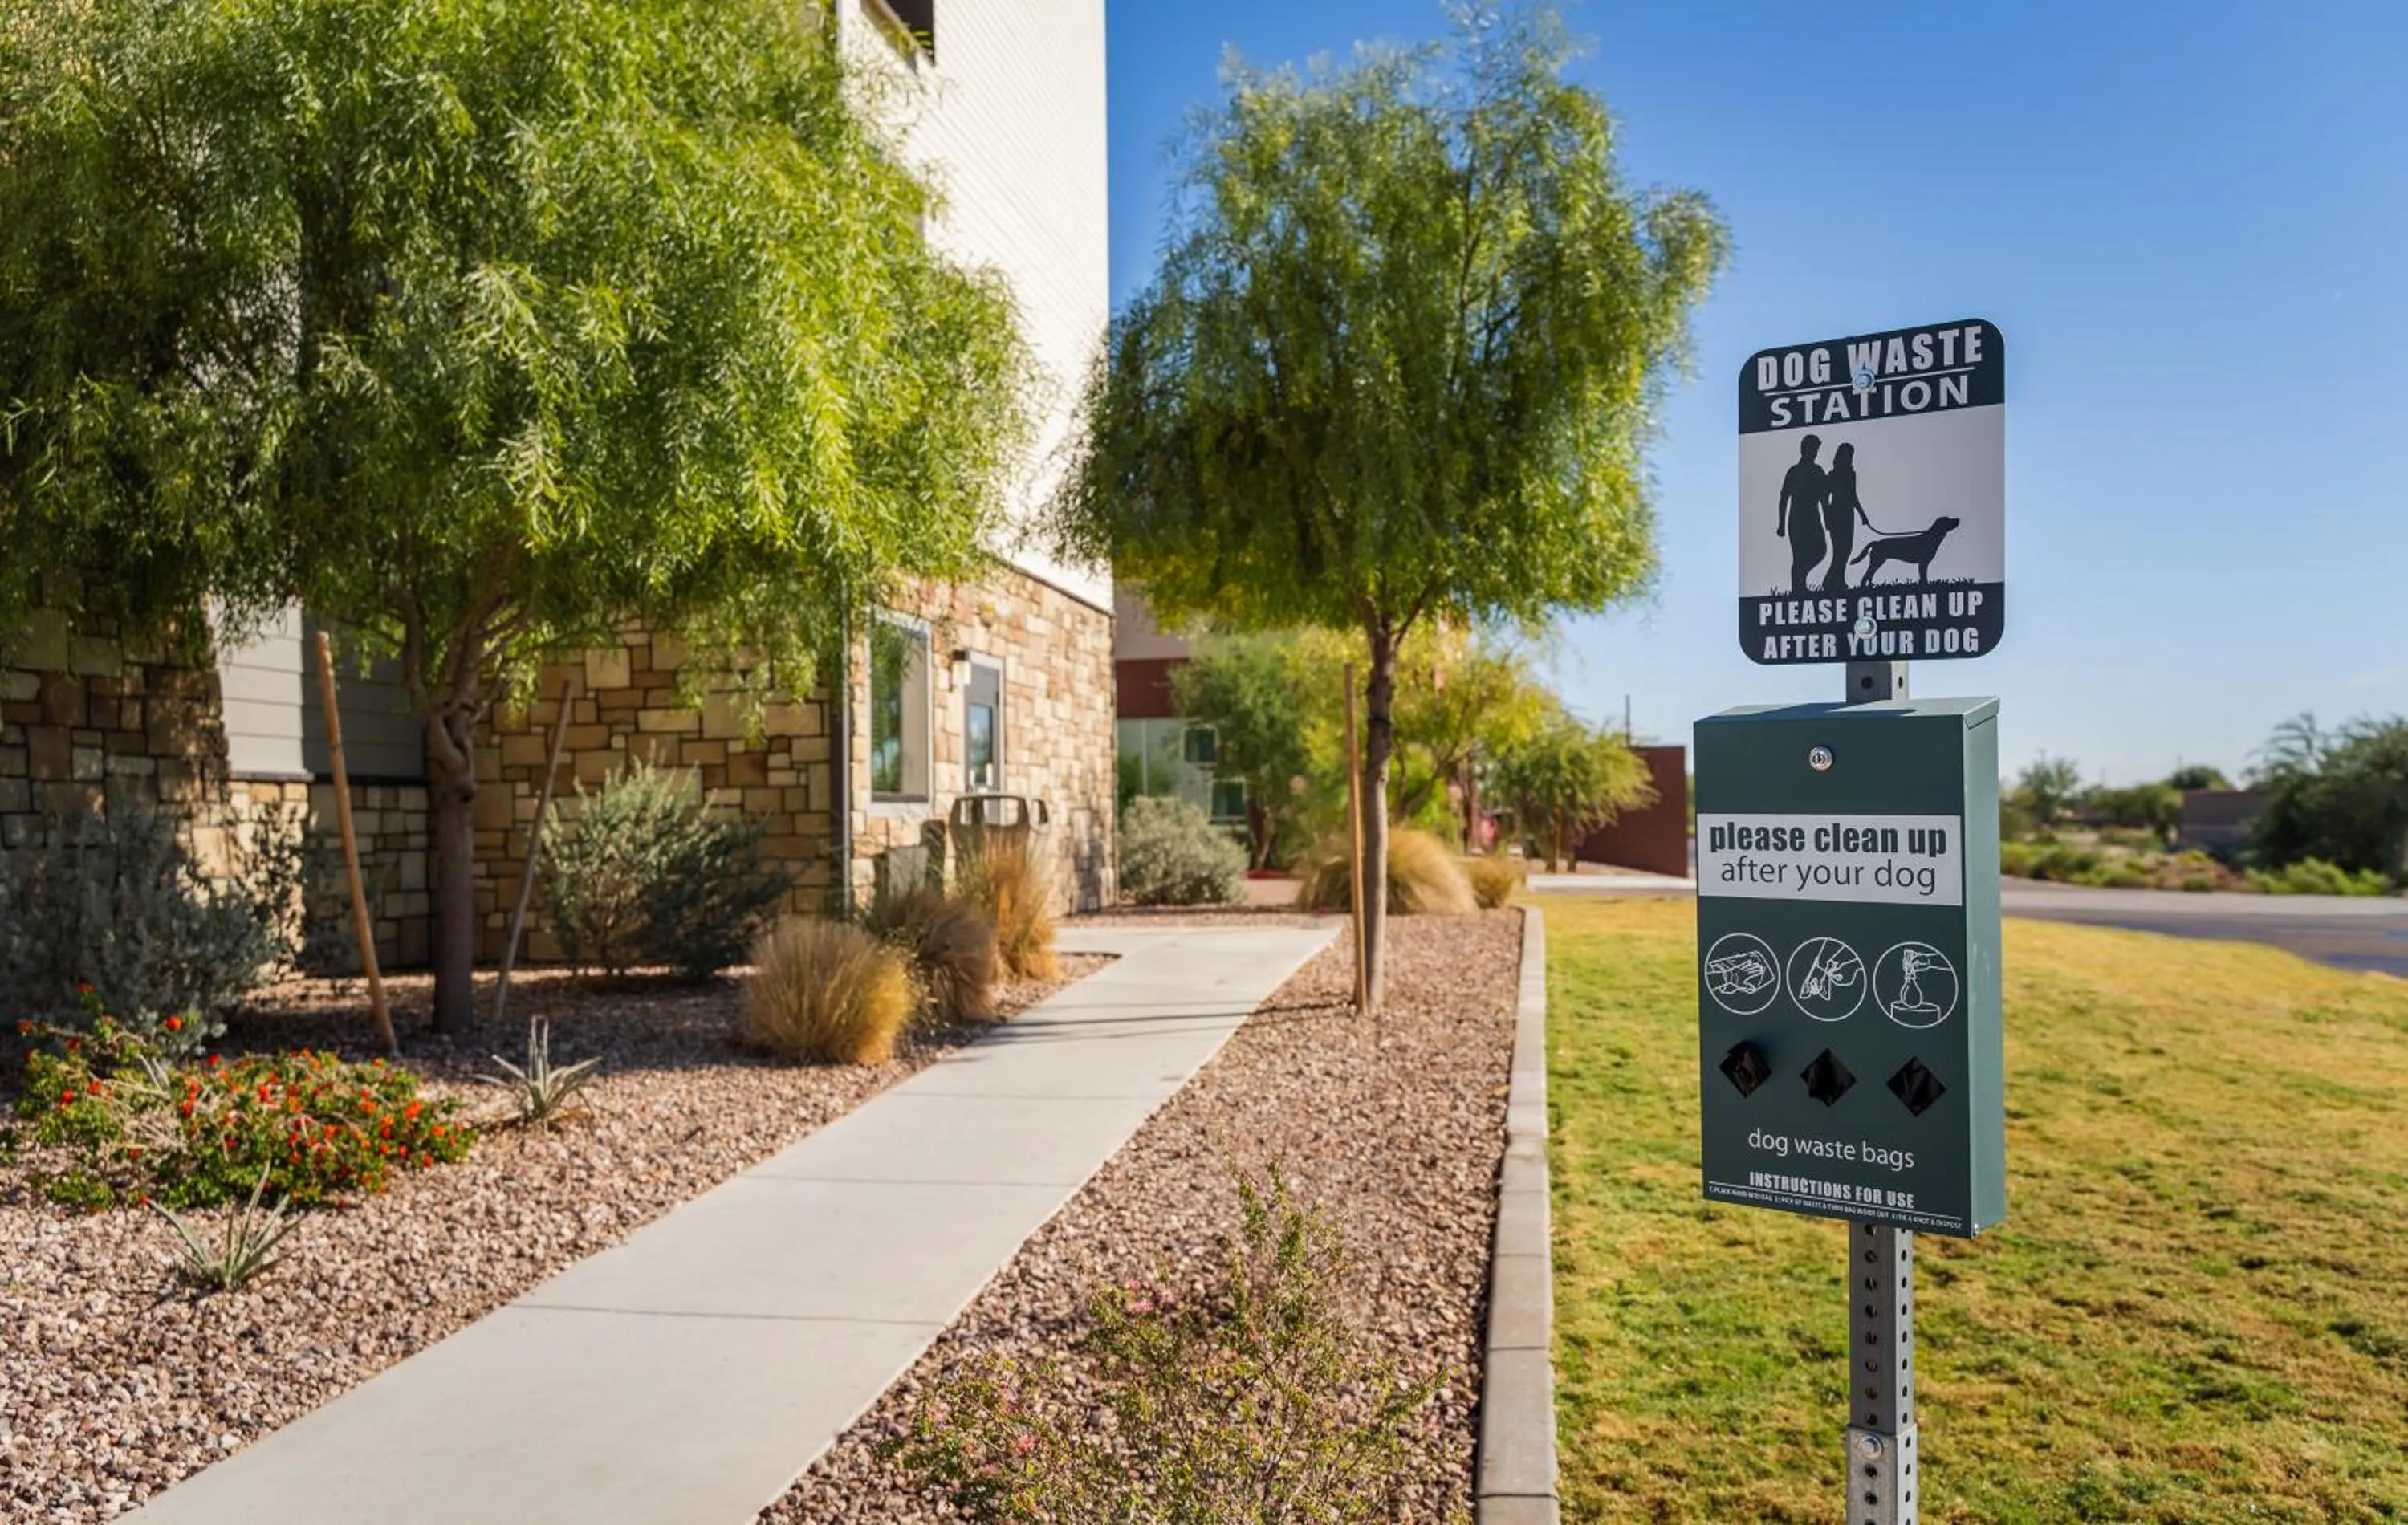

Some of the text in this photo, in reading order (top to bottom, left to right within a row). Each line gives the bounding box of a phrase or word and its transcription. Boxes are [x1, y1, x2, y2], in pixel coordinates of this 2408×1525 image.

[1758, 326, 1981, 390] DOG WASTE
[1771, 375, 1967, 426] STATION
[1759, 591, 1983, 625] PLEASE CLEAN UP
[1764, 628, 1978, 659] AFTER YOUR DOG
[1710, 822, 1946, 857] please clean up
[1721, 856, 1934, 896] after your dog
[1748, 1128, 1914, 1171] dog waste bags
[1750, 1172, 1851, 1199] INSTRUCTIONS
[1856, 1186, 1881, 1204] FOR
[1887, 1191, 1914, 1208] USE
